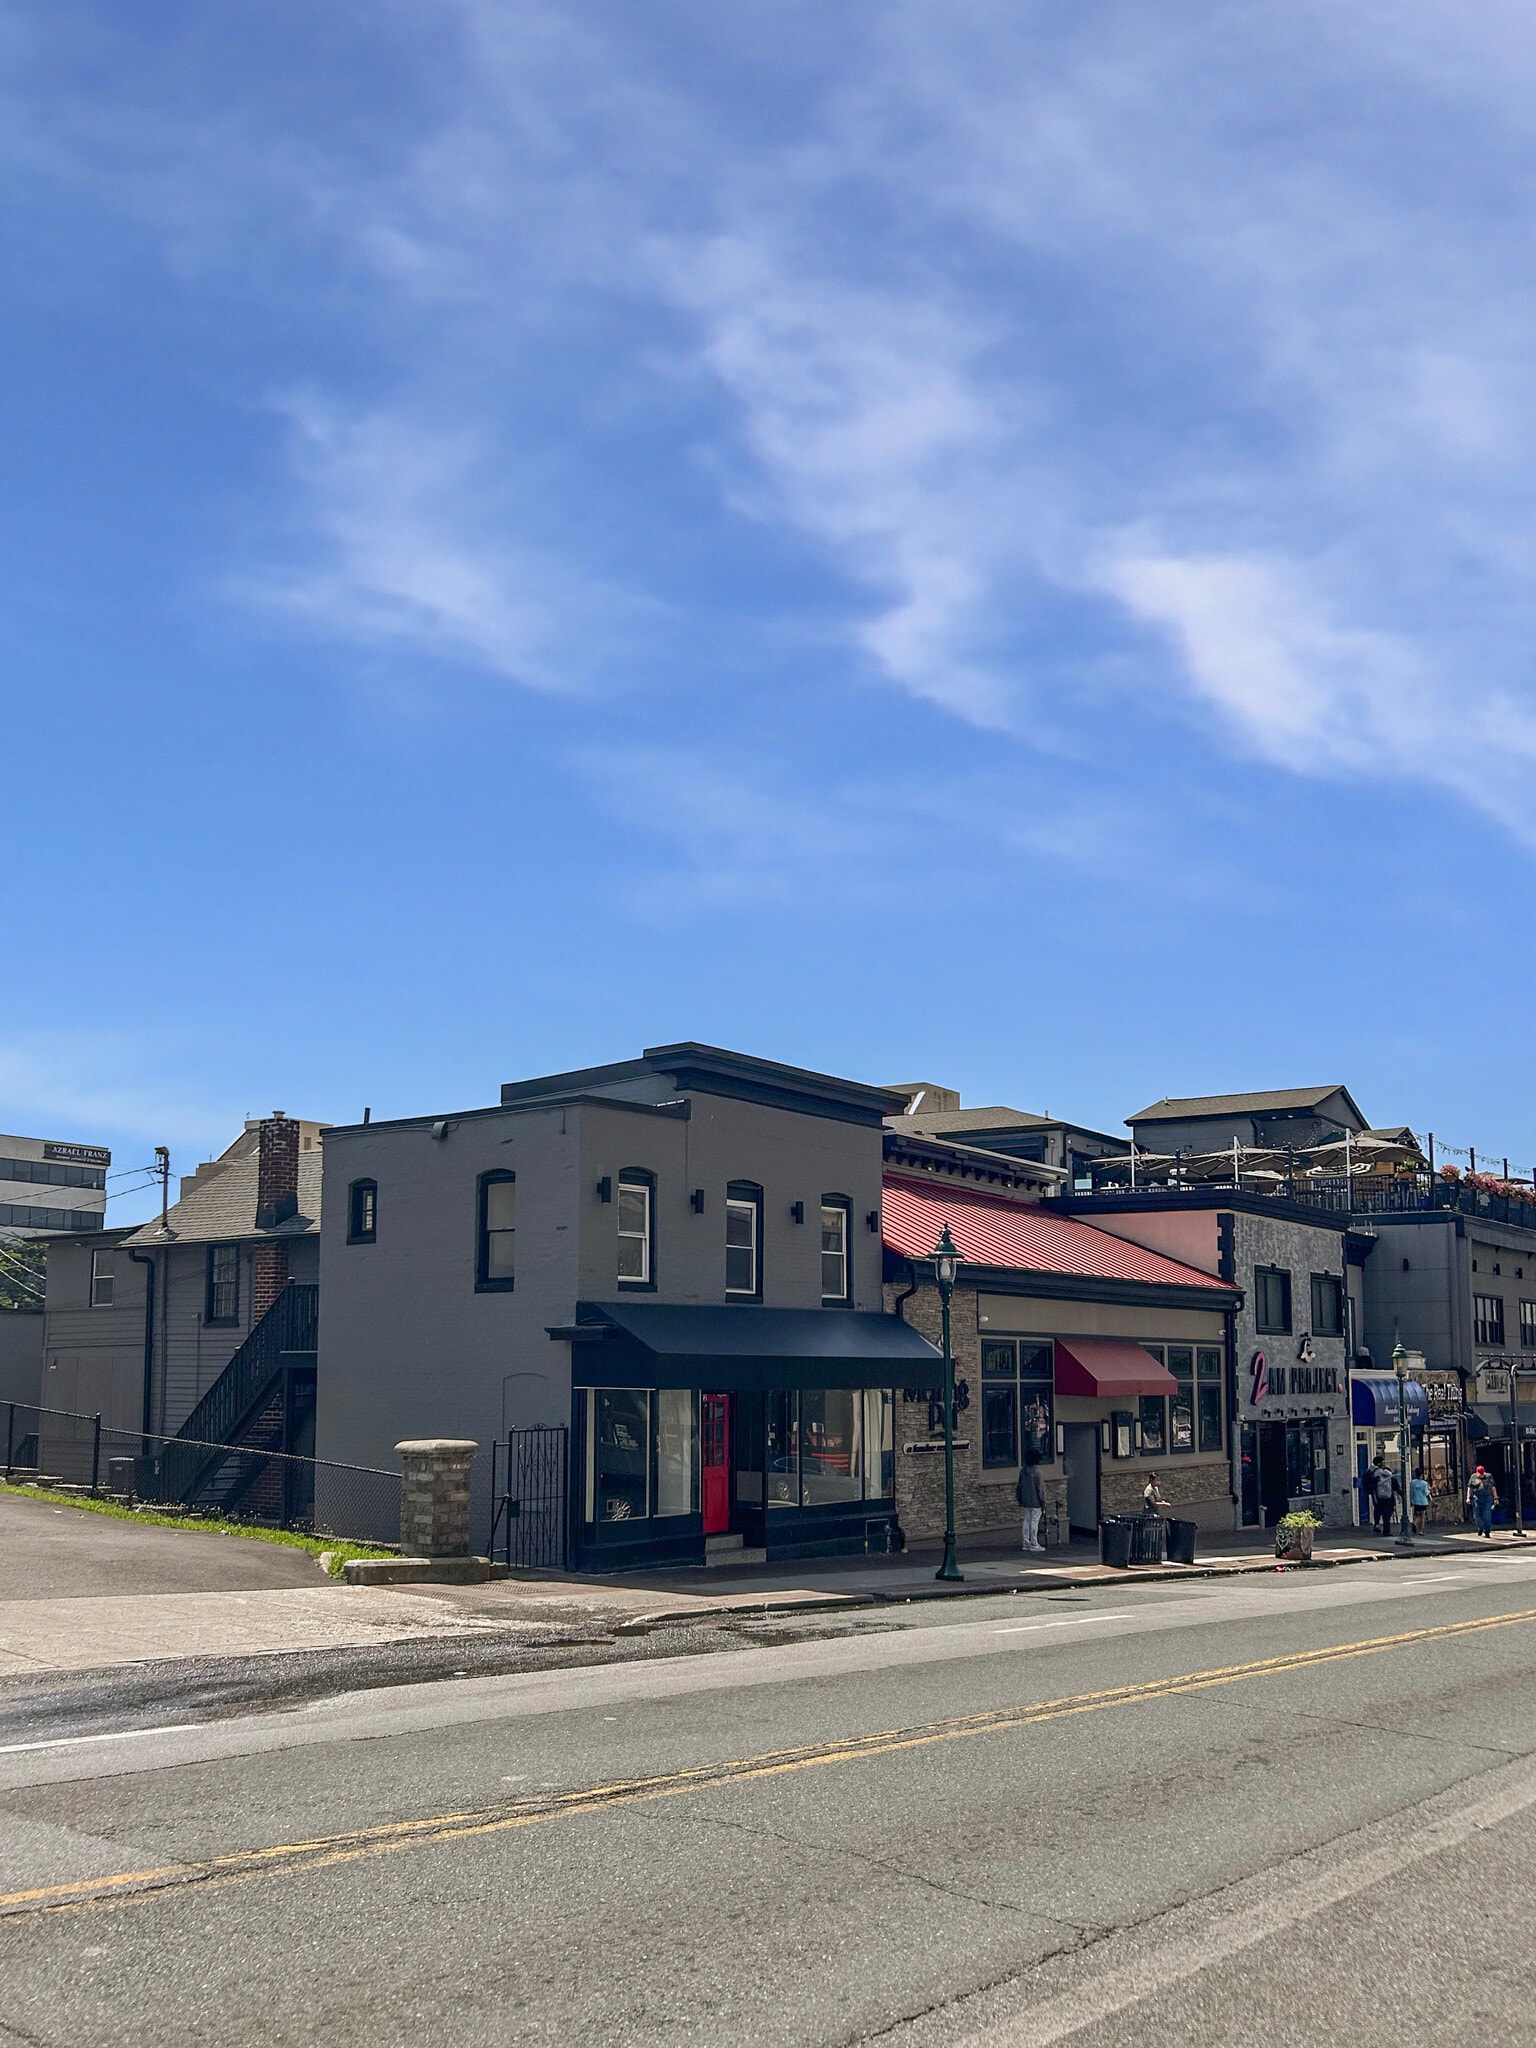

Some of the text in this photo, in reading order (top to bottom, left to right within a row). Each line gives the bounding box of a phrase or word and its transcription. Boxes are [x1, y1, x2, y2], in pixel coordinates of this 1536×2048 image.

[52, 1146, 80, 1156] AZRAEL
[83, 1149, 108, 1159] FRANZ
[1250, 1351, 1269, 1406] 2
[1268, 1367, 1286, 1395] AM
[1433, 1384, 1446, 1401] Real
